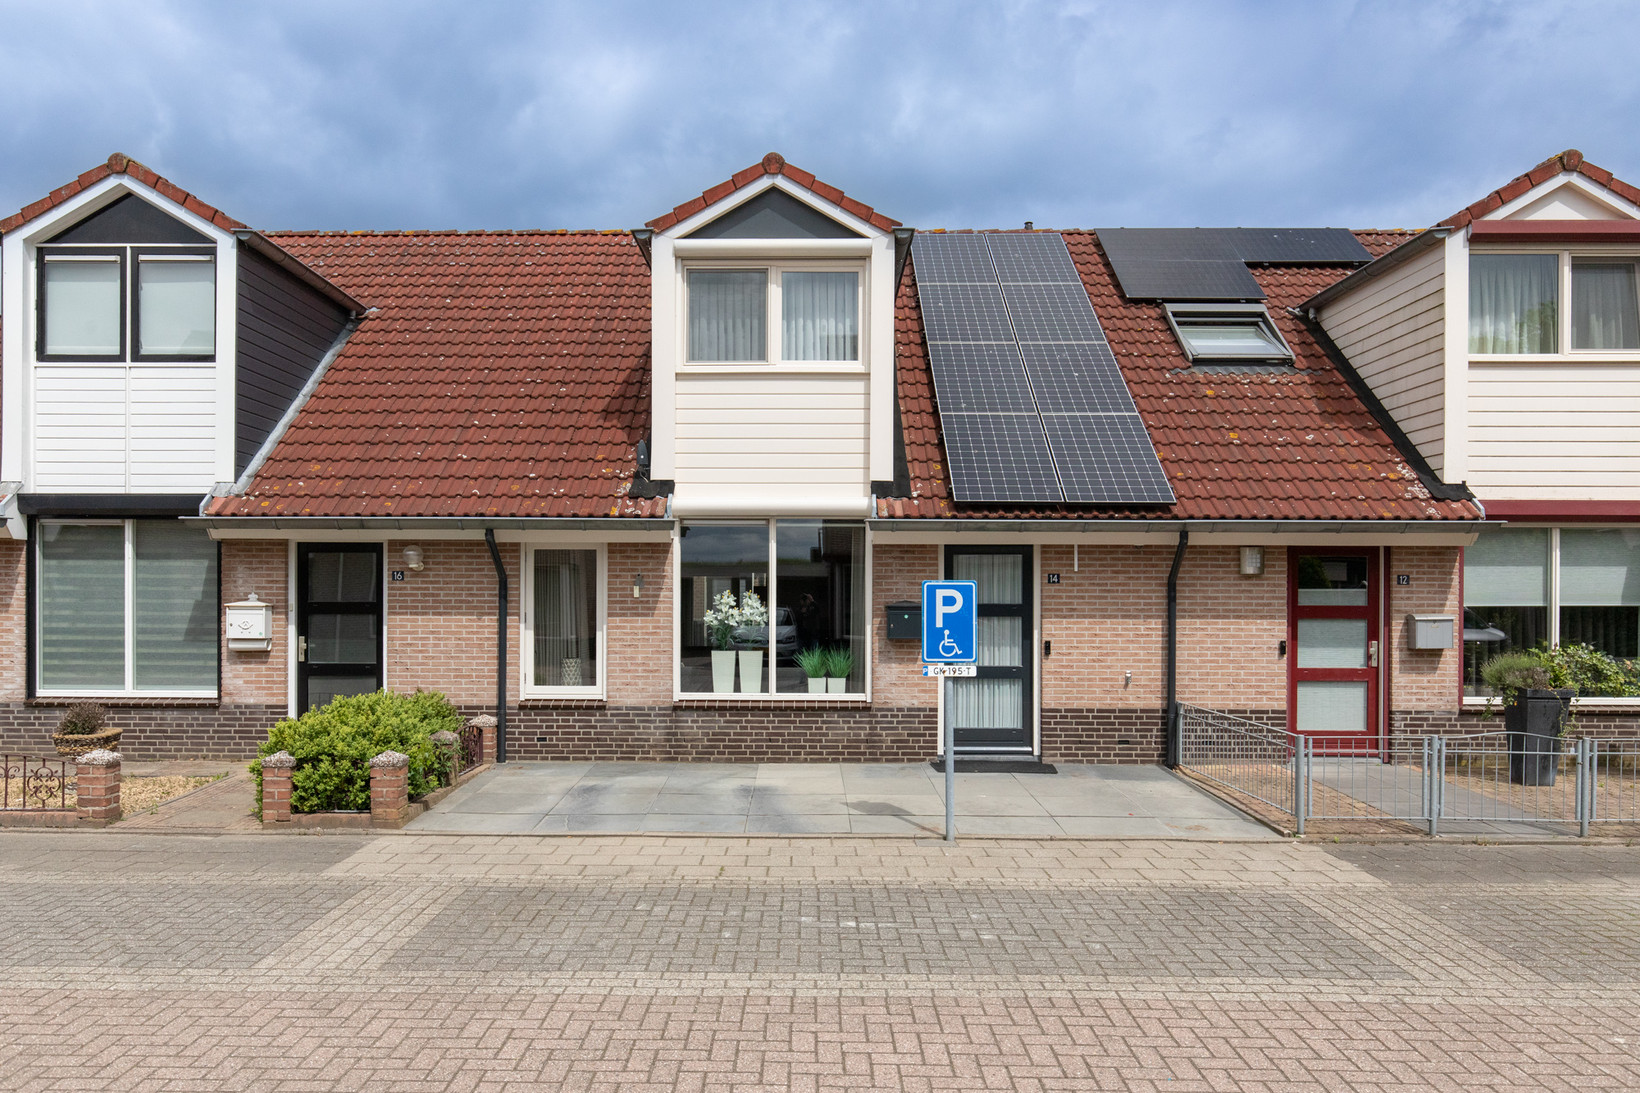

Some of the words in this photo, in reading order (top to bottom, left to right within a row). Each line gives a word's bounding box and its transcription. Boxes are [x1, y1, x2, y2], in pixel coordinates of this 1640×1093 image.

[394, 571, 402, 580] 16
[1050, 574, 1058, 583] 14
[1400, 575, 1408, 584] 12
[936, 589, 963, 627] P
